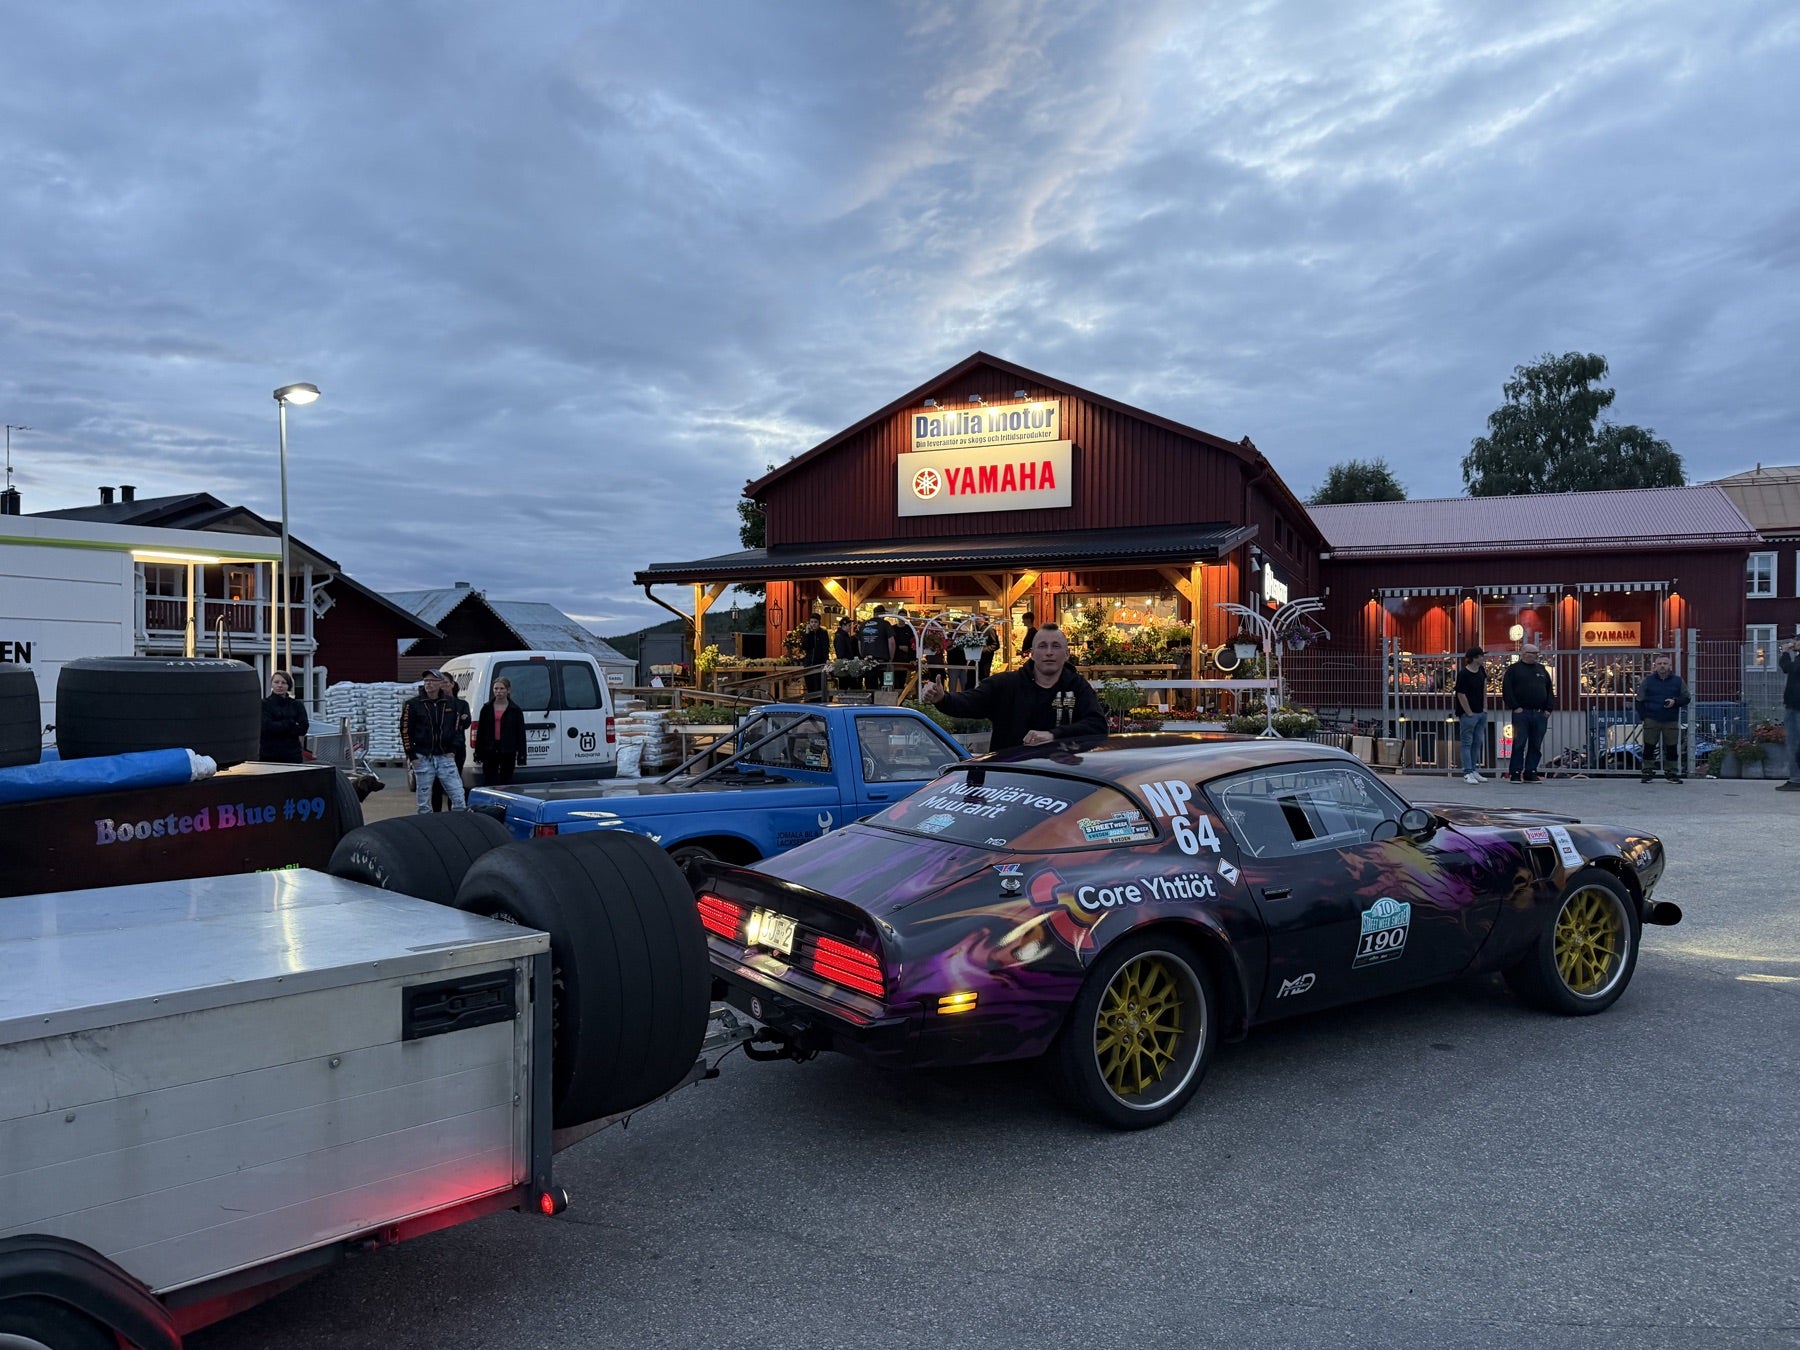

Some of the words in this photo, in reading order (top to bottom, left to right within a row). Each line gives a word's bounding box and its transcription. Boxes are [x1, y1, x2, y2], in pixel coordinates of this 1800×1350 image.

[988, 407, 1055, 433] motor
[987, 434, 1000, 442] och
[1000, 430, 1052, 442] fritidsprodukter
[944, 460, 1056, 496] YAMAHA
[1596, 629, 1636, 642] YAMAHA
[527, 745, 550, 754] motor
[918, 795, 1007, 819] Muurarit
[941, 782, 1068, 814] Nurmijärven
[1139, 780, 1192, 818] NP
[95, 806, 210, 846] Boosted
[217, 803, 276, 830] Blue
[283, 797, 326, 823] #99
[1171, 815, 1221, 855] 64
[1078, 884, 1142, 910] Core
[1141, 873, 1217, 900] Yhtiöt
[1379, 901, 1393, 916] 10
[1380, 916, 1391, 930] WEEK
[1362, 928, 1405, 954] 190
